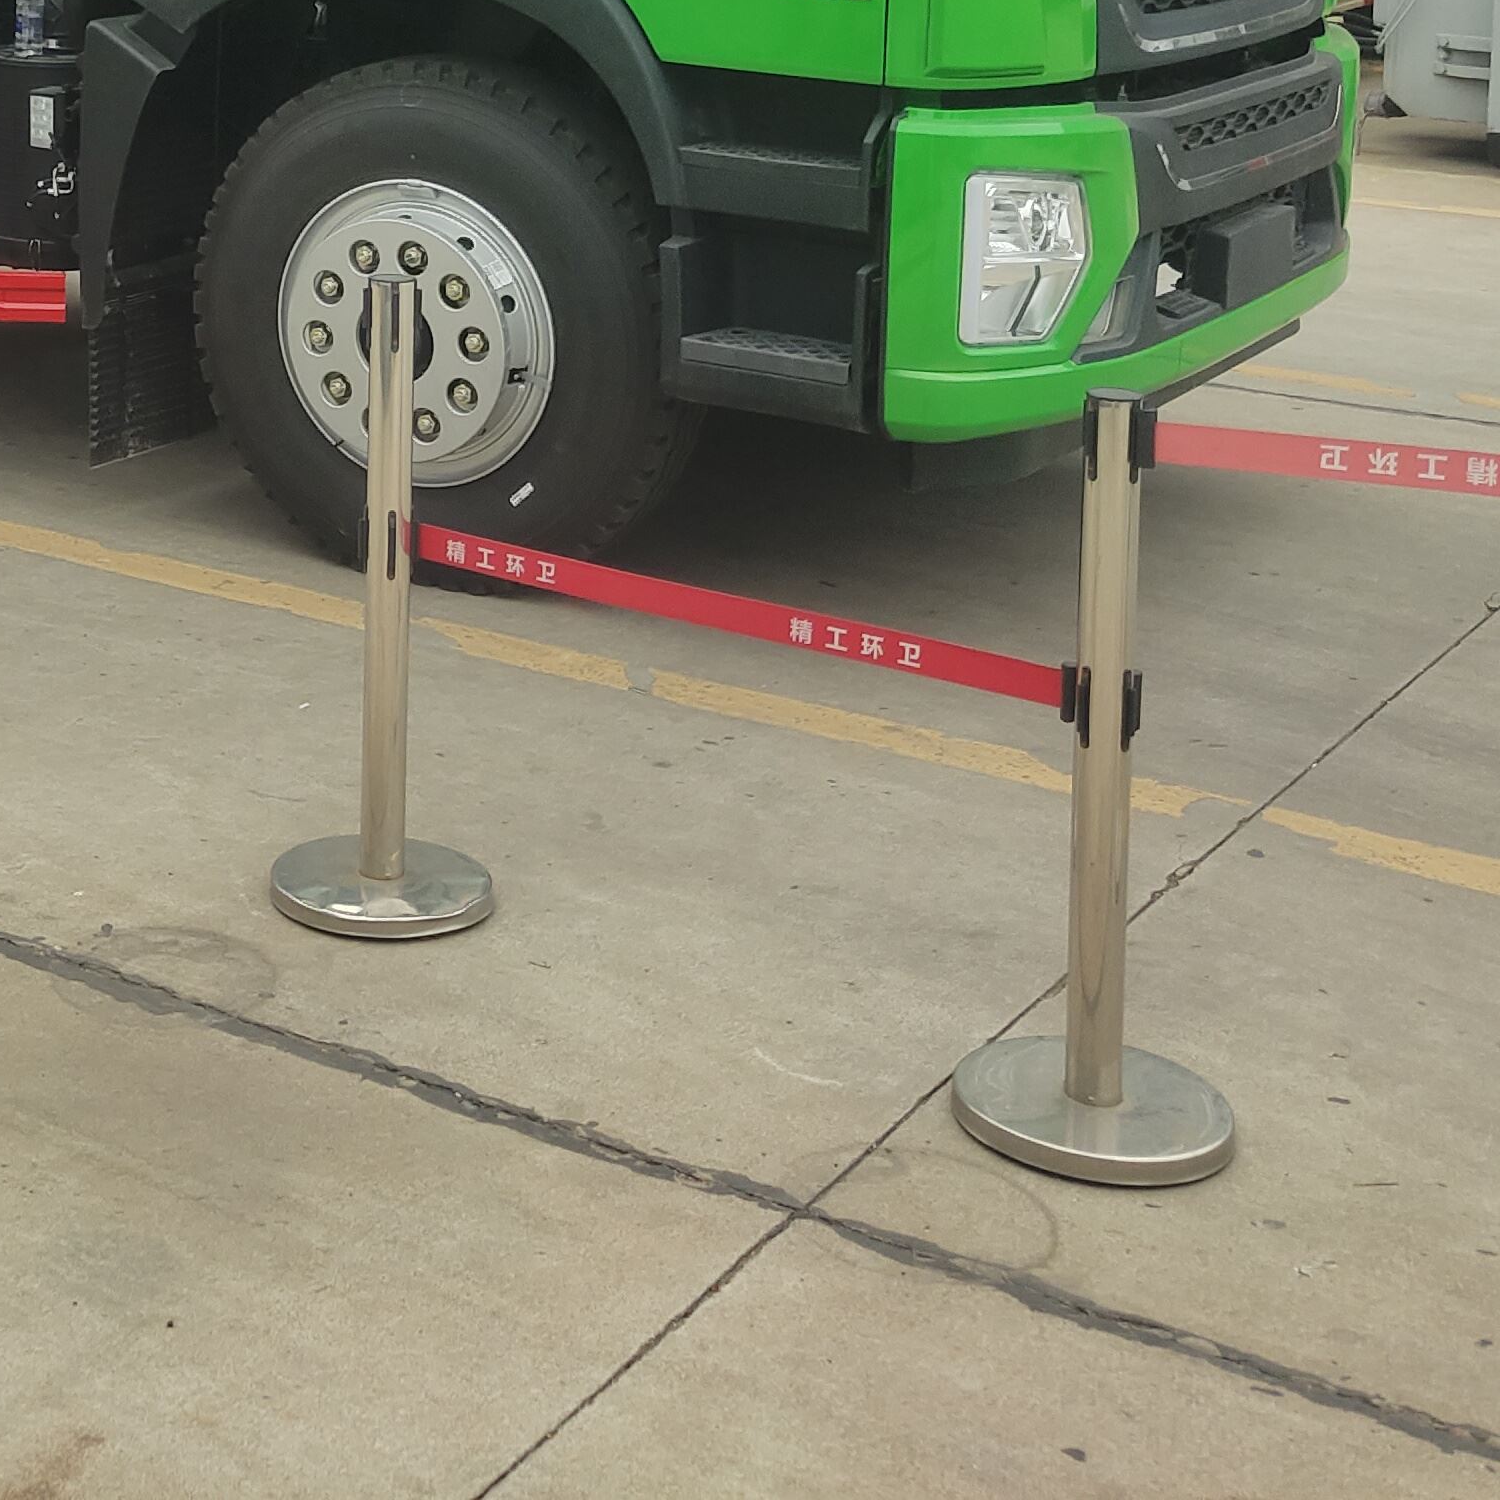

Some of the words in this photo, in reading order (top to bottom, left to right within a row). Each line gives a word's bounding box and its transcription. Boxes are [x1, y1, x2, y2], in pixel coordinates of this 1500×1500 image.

[1319, 444, 1499, 488] 精工环卫
[446, 538, 557, 586] 精工环卫
[788, 616, 922, 669] 精工环卫
